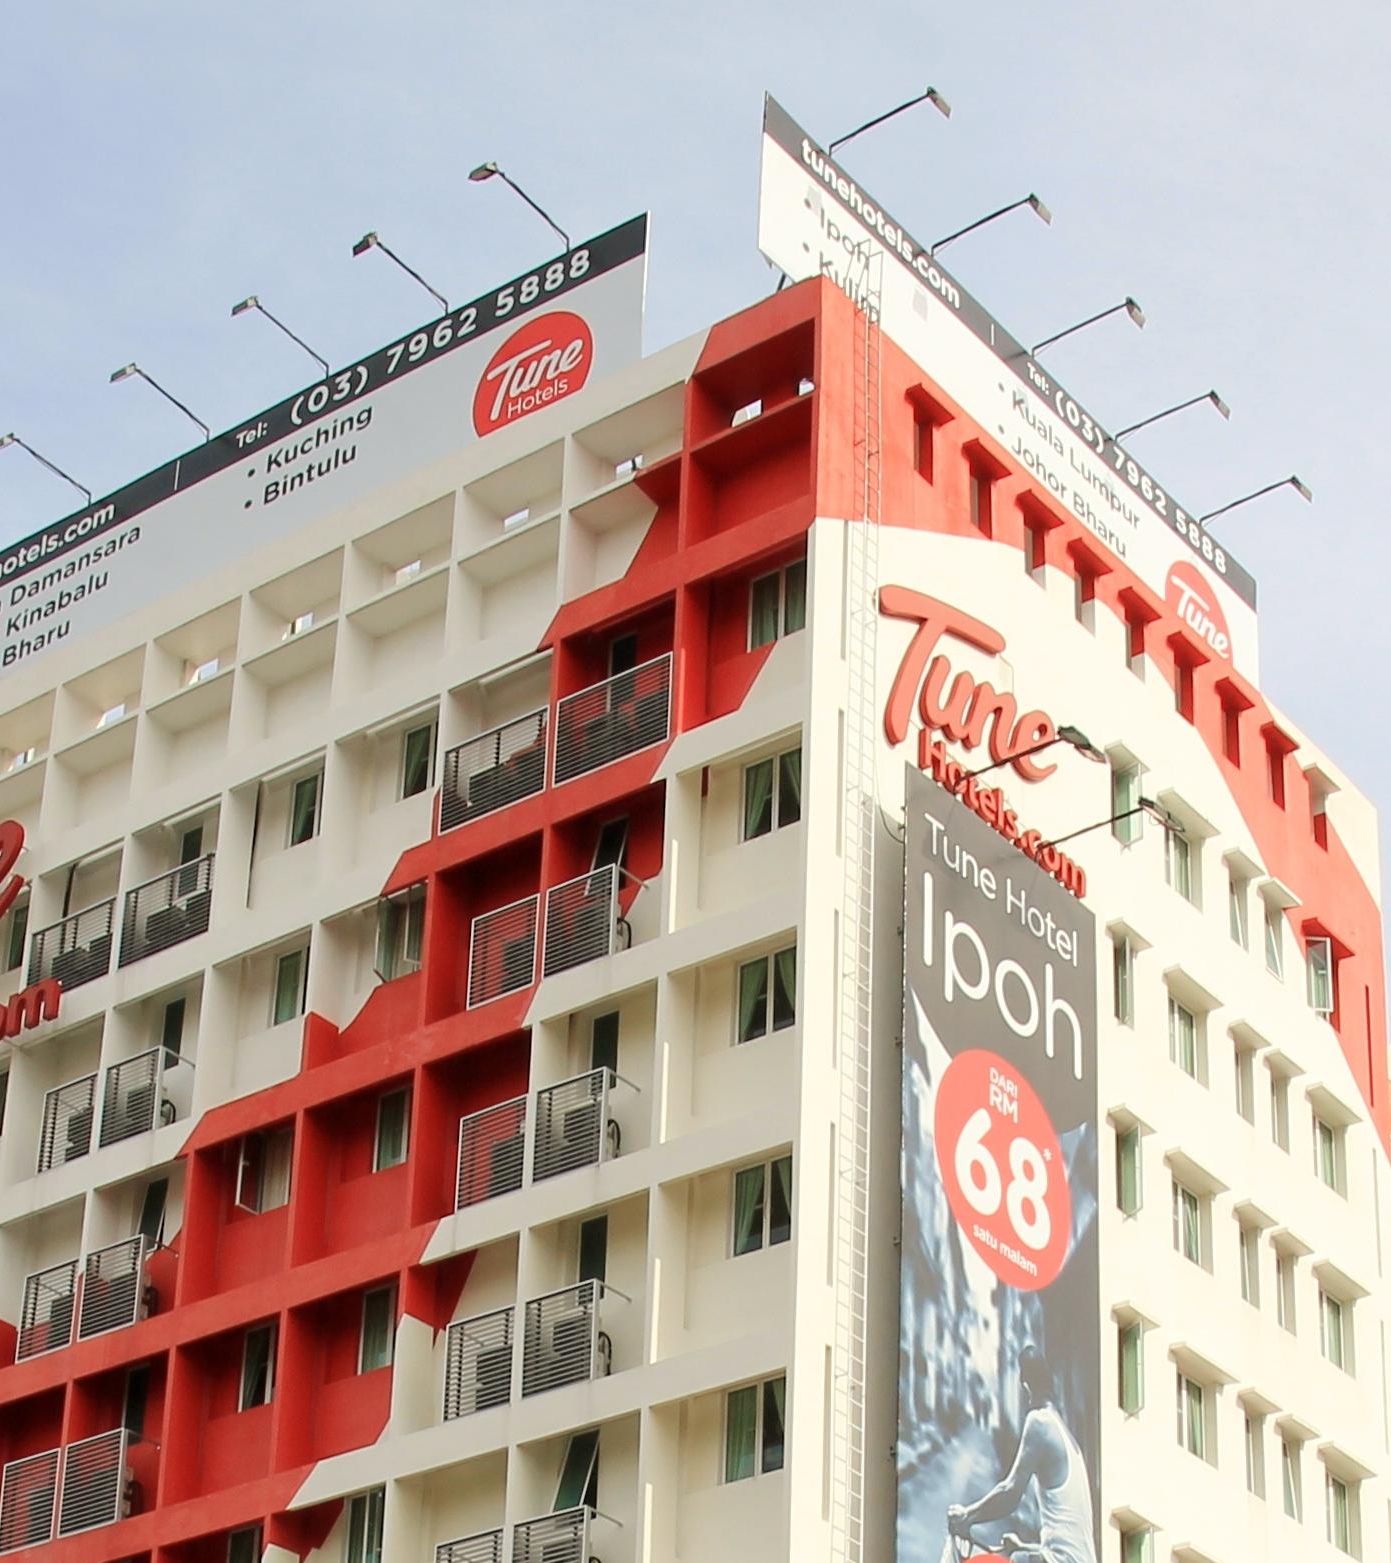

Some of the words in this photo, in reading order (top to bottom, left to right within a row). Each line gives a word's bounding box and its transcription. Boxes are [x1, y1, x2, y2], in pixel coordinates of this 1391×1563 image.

[802, 138, 960, 308] tunehotels.com
[821, 207, 870, 271] Ipoh
[236, 423, 269, 449] Tel:
[290, 365, 370, 425] (03)
[385, 307, 478, 374] 7962
[495, 249, 592, 317] 5888
[486, 338, 584, 421] Tune
[507, 378, 568, 419] Hotels
[263, 445, 358, 505] Bintulu
[266, 406, 374, 475] Kuching
[1012, 389, 1065, 457] Kuala
[1069, 446, 1141, 530] Lumpur
[1026, 362, 1050, 395] Tel:
[1055, 390, 1106, 454] (03)
[1113, 446, 1168, 517] 7962
[1175, 513, 1227, 574] 5888
[1011, 436, 1068, 499] Johor
[1073, 490, 1127, 559] Bharu
[6, 571, 110, 636] Kinabalu
[10, 525, 142, 607] Damansara
[2, 620, 72, 667] Bharu
[1171, 574, 1230, 659] Tune
[876, 583, 1059, 783] Tune
[917, 727, 1089, 900] Hotels.com
[923, 811, 998, 900] Tune
[1004, 877, 1078, 968] Hotel
[921, 871, 1083, 1081] Ipoh
[989, 1067, 1018, 1099] DARI
[989, 1082, 1019, 1124] RM
[973, 1223, 998, 1250] satu
[999, 1238, 1038, 1277] malam
